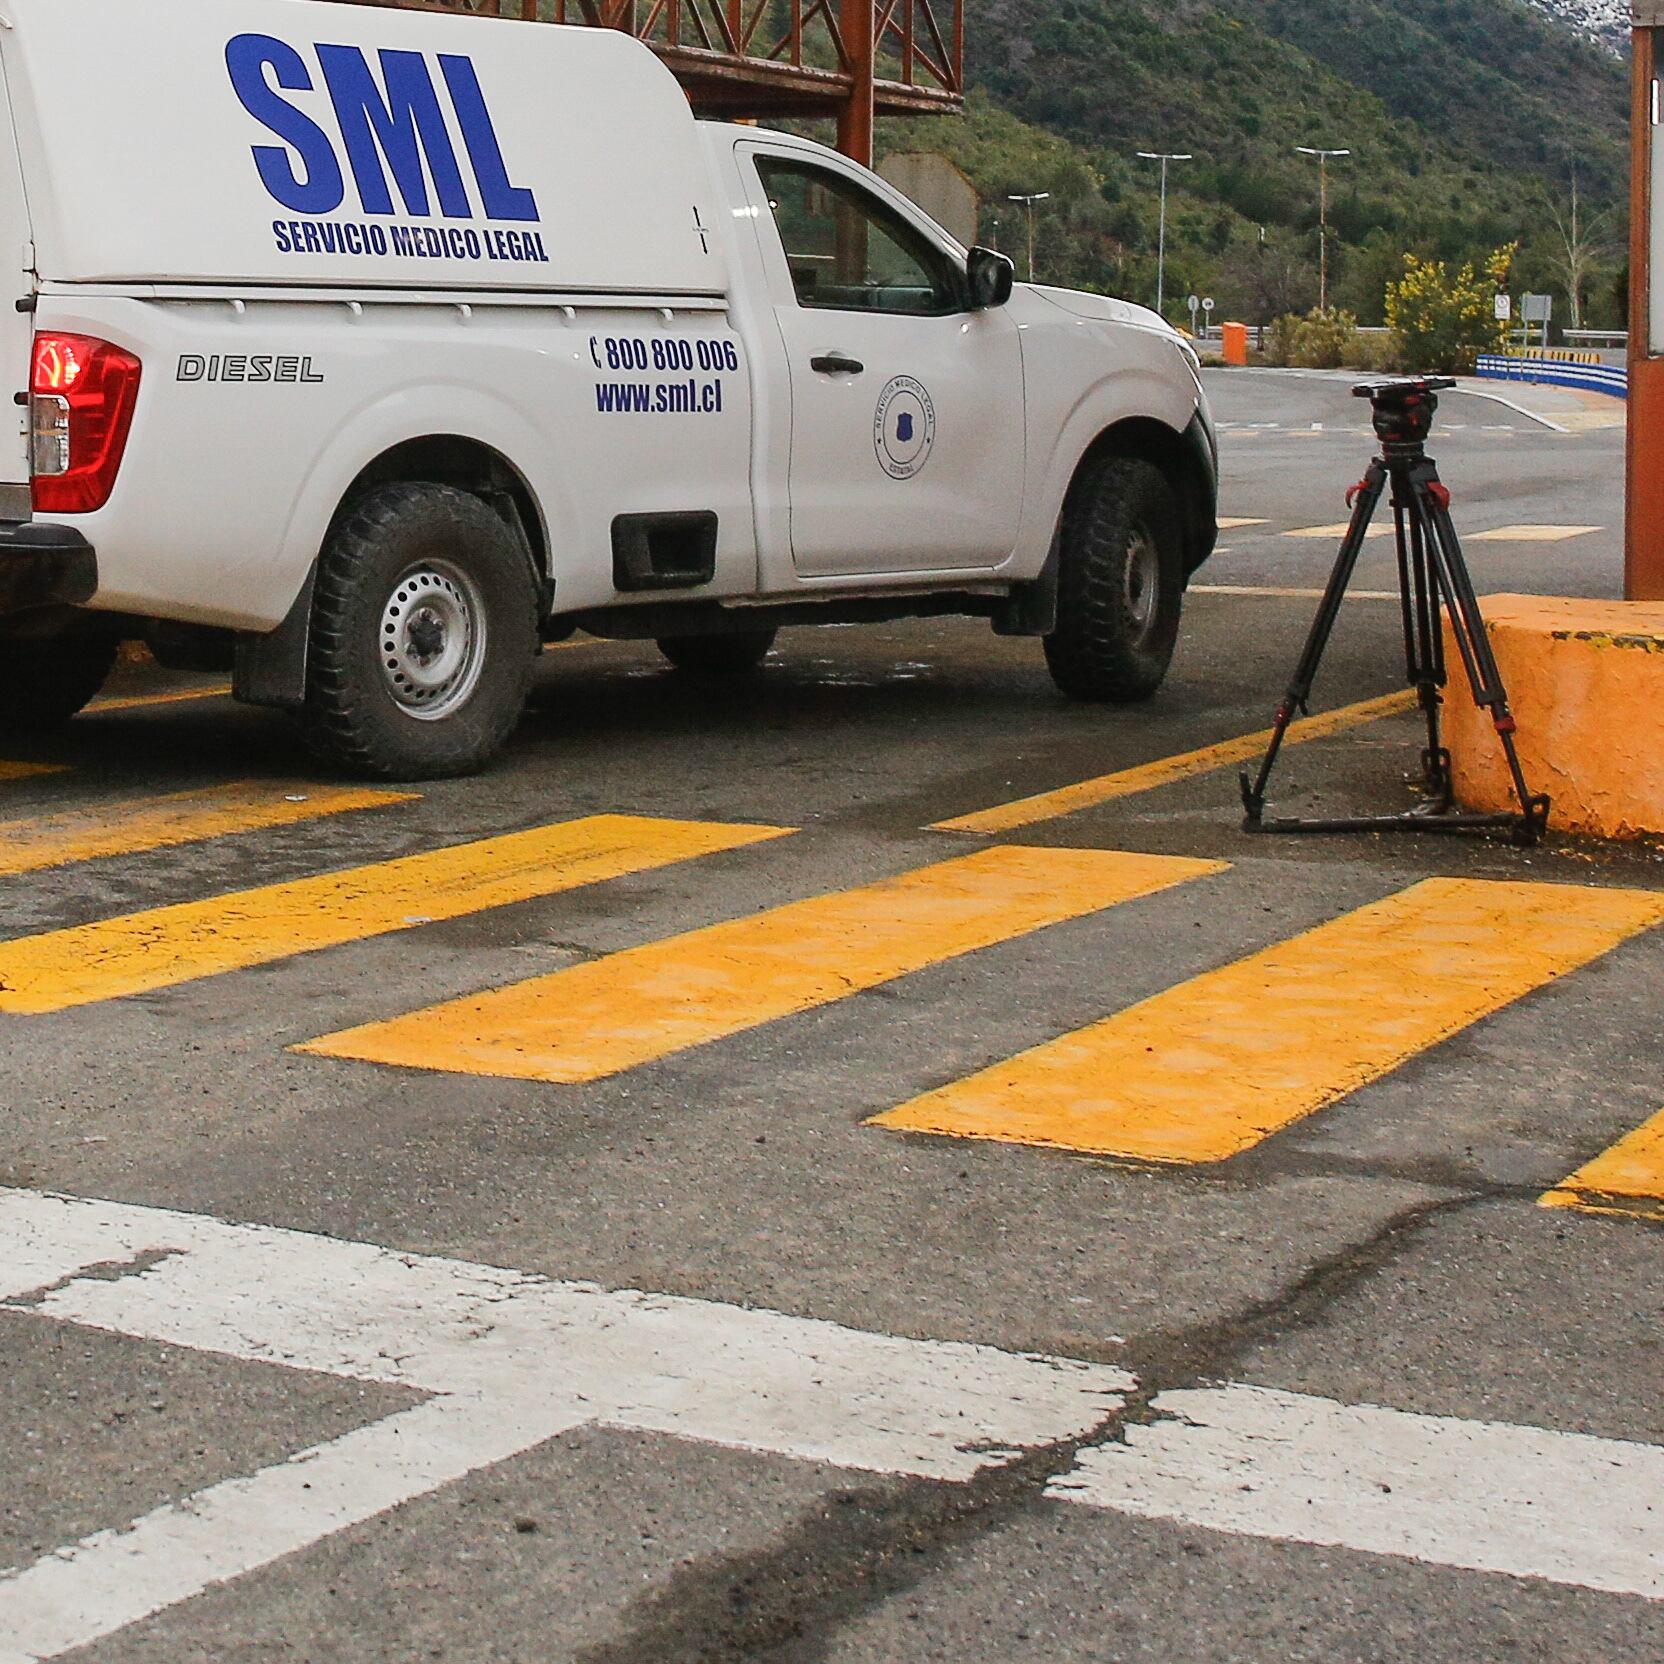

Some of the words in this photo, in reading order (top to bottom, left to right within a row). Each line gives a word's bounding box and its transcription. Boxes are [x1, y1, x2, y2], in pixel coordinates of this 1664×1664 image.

[224, 32, 541, 222] SML
[272, 220, 387, 256] SERVICIO
[390, 225, 481, 260] MEDICO
[483, 229, 550, 262] LEGAL
[176, 354, 325, 383] DIESEL
[604, 338, 648, 370] 800
[651, 338, 694, 371] 800
[696, 339, 738, 372] 006
[595, 378, 722, 413] www.sml.cl
